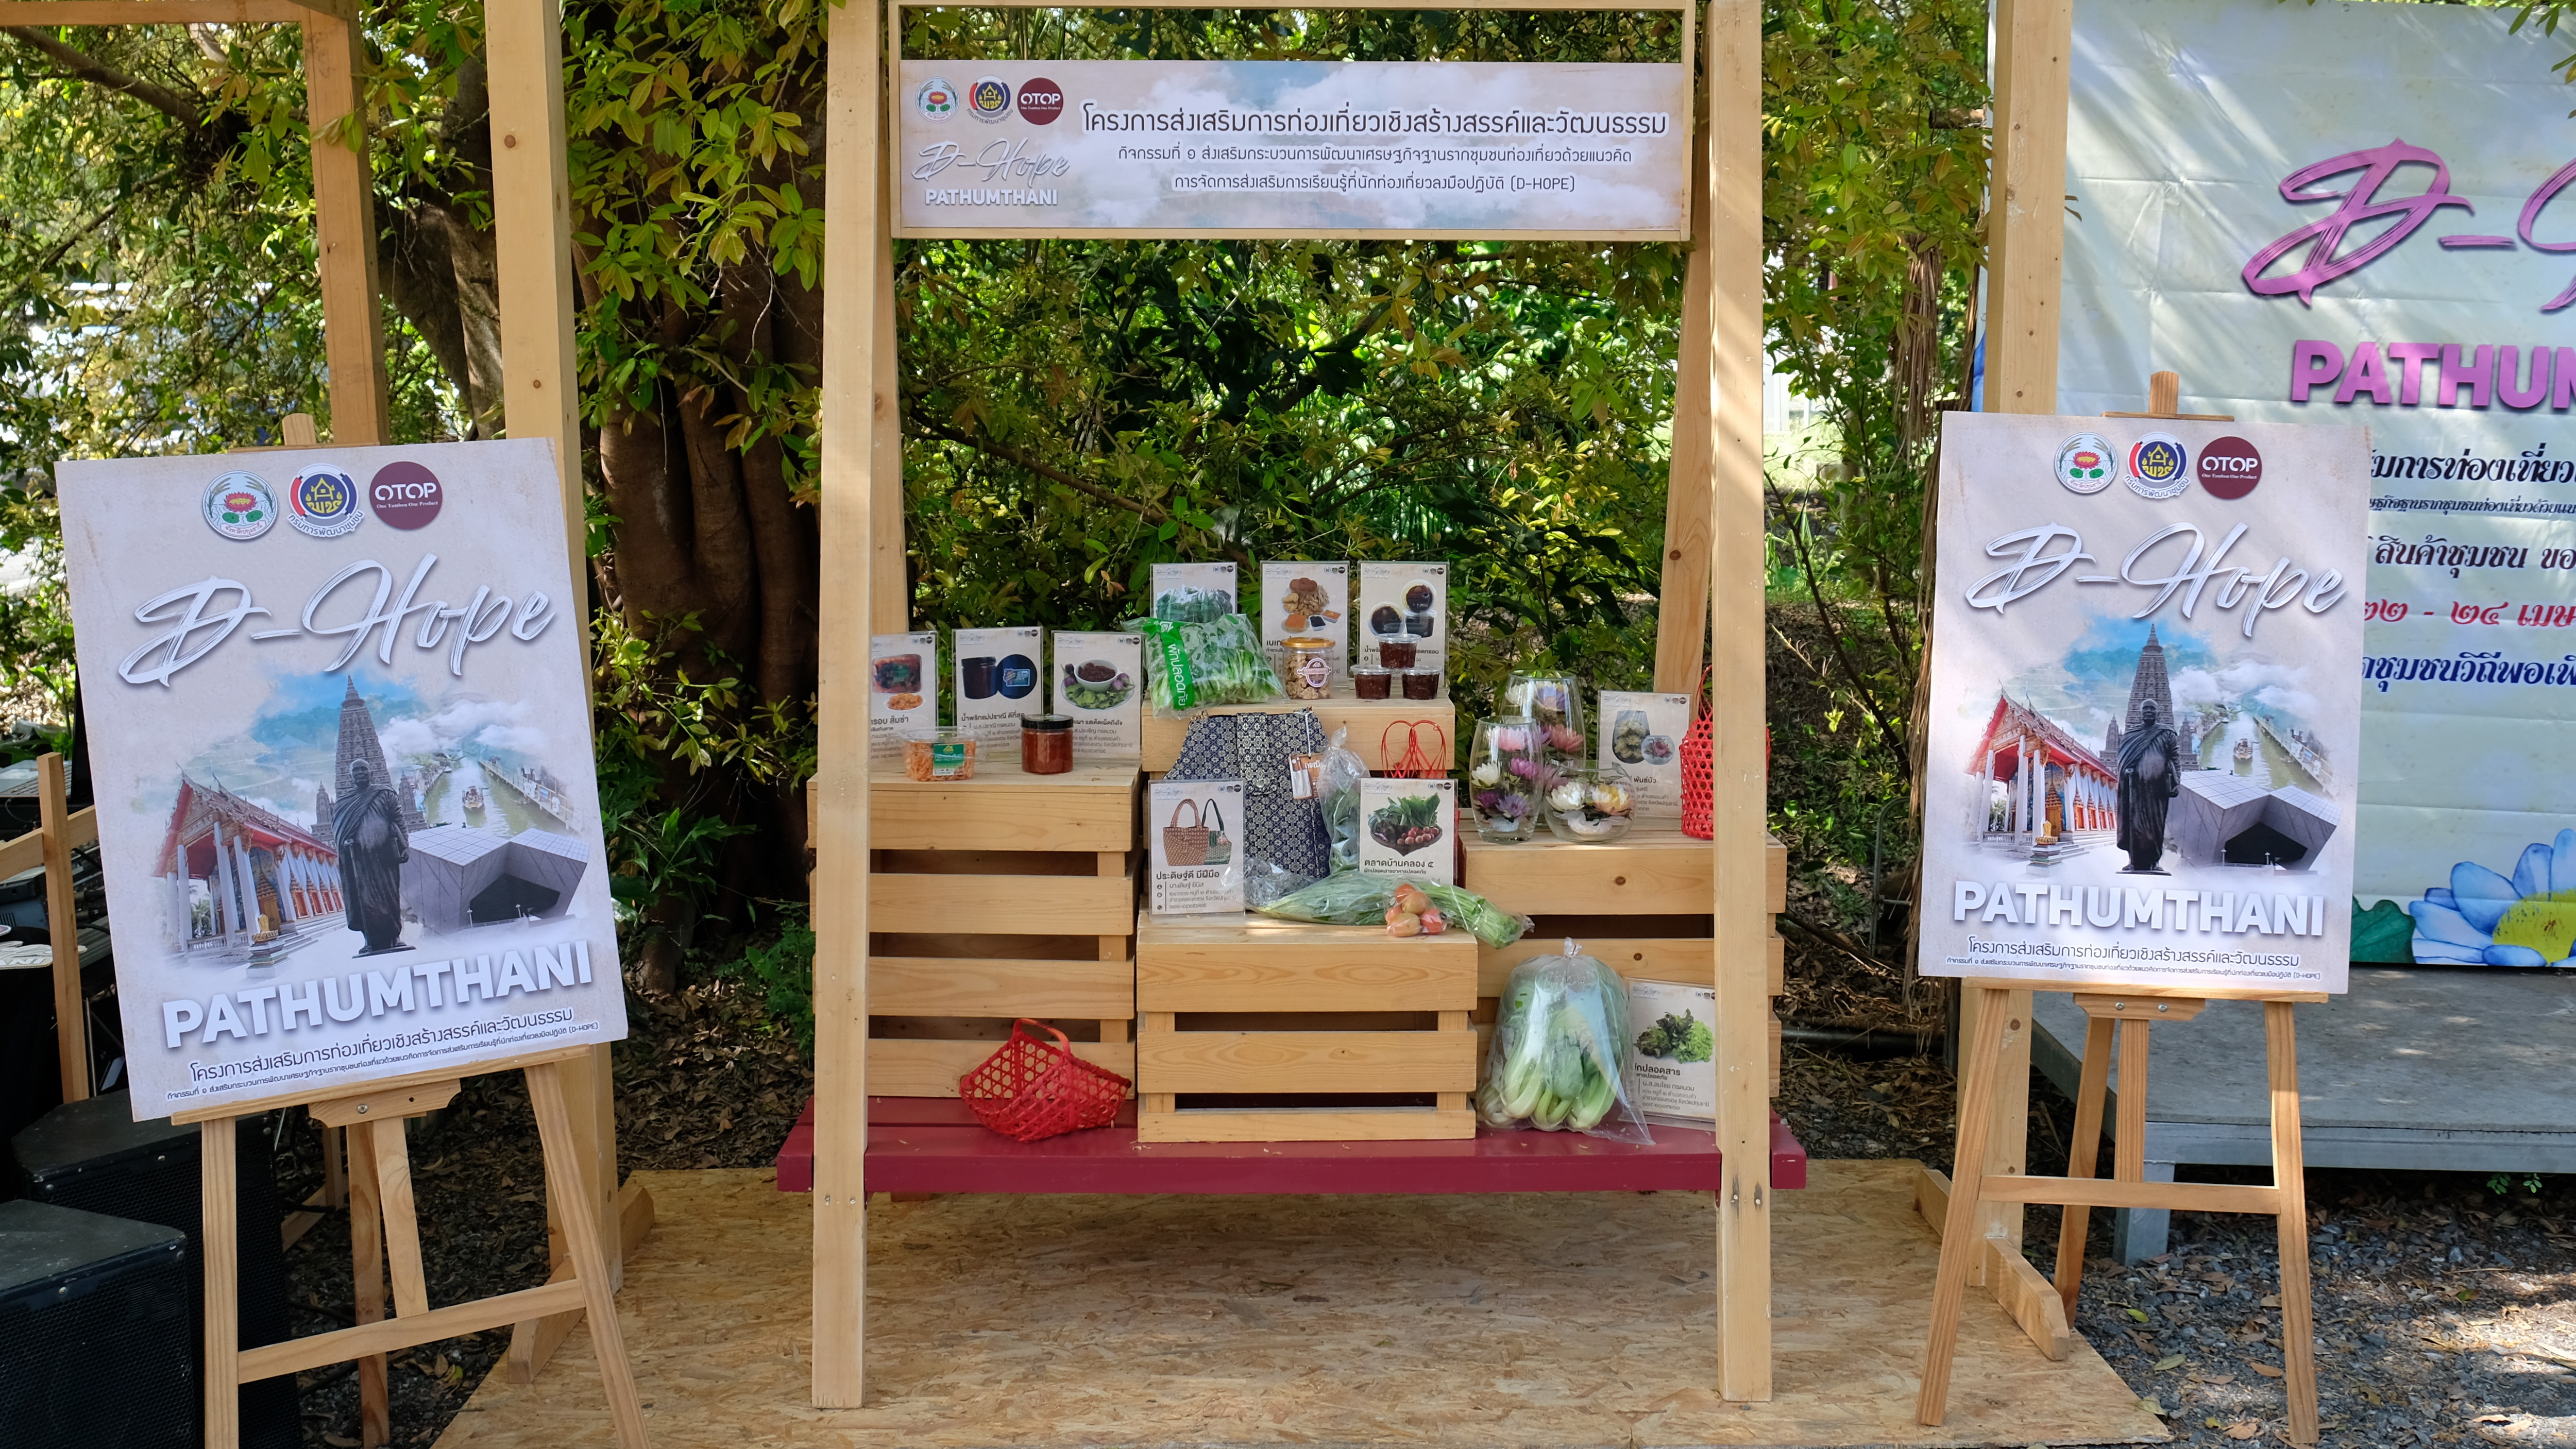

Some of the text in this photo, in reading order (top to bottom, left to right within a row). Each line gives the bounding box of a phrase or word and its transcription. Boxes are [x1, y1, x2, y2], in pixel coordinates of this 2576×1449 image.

[1020, 93, 1061, 105] OTOP
[1083, 102, 1667, 134] โครงการส่งเสริมการท่องเที่ยวเชิงสร้างสรรค์และวัฒนธรรม
[911, 137, 1070, 189] D-Hope
[1118, 142, 1181, 160] กิจกรรมที่
[1202, 144, 1632, 165] ส่งเสริมกระบวนการพัฒนาเศรษฐกิจฐานรากชุมชนท่องเที่ยวด้วยแนวคิด
[1175, 171, 1575, 193] การจัดการส่งเสริมการเรียนรู้ที่นักท่องเที่ยวลงมือปฏิบัติ (D-HOPE)
[925, 189, 1058, 205] PATHUMTHANI
[2242, 137, 2576, 313] D-
[2202, 456, 2258, 472] OTOP
[375, 482, 437, 501] OTOP
[2124, 475, 2189, 498] กรมการพัฒนาชุมชน
[288, 511, 363, 537] กรมการพัฒนาชุมชน
[2375, 534, 2529, 578] สินค้าชุมชน
[1965, 521, 2347, 638] D-Hope
[118, 552, 556, 688] D-Hope
[1364, 858, 1426, 867] ตลาดบ้านคลอง
[1954, 880, 2324, 937] PATHUMTHANI
[162, 940, 594, 1049] PATHUMTHANI
[190, 1008, 573, 1082] โครงการส่งเสริมการท่องเที่ยวเชิงสร้างสรรค์และวัฒนธรรม
